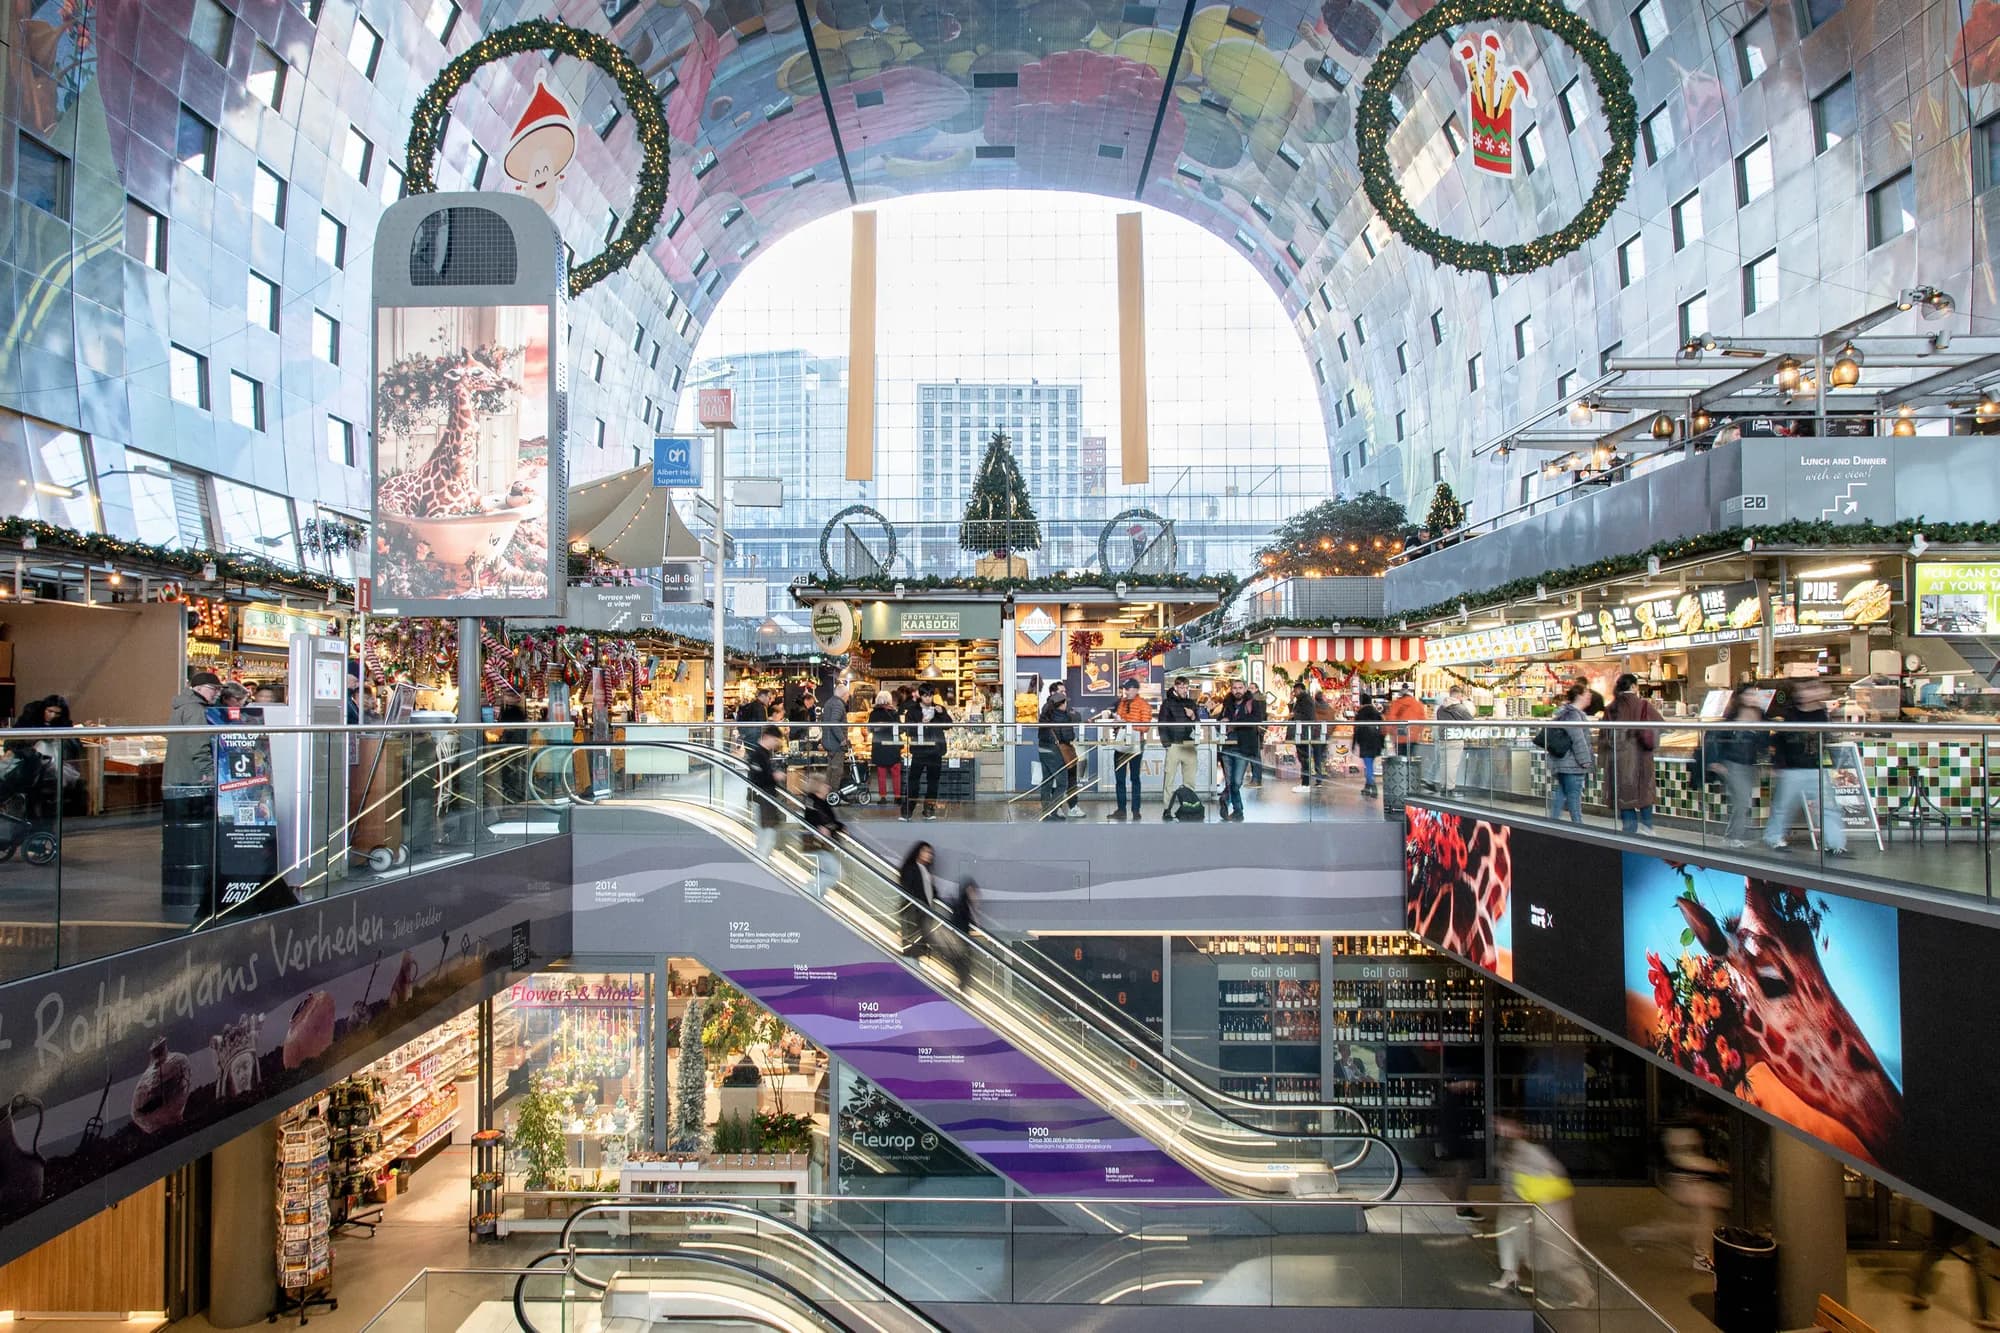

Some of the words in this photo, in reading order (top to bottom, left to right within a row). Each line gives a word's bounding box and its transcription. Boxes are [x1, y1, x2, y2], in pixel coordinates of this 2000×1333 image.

[1805, 469, 1829, 481] with
[1844, 466, 1873, 479] view!
[657, 477, 698, 485] Supermarkt
[1744, 496, 1766, 509] 20
[1924, 568, 1953, 578] YOU
[1956, 568, 1985, 577] CAN
[664, 574, 680, 584] Gall
[684, 574, 700, 584] Gall
[1802, 582, 1838, 600] PIDE
[1930, 581, 1945, 591] AT
[1949, 581, 1986, 591] YOUR
[614, 600, 631, 608] view
[903, 620, 958, 630] KAASDOK
[187, 637, 220, 657] Corona
[594, 881, 618, 890] 2014
[684, 880, 699, 888] 2001
[729, 922, 750, 931] 1972
[1251, 967, 1271, 978] Gall
[1276, 967, 1297, 978] Gall
[1362, 967, 1382, 978] Gall
[1388, 967, 1409, 978] Gall
[34, 950, 260, 1068] Rotterdams
[270, 912, 385, 978] Verheden
[392, 916, 414, 940] Jules
[511, 985, 572, 1001] Flowers
[577, 986, 590, 1001] &
[597, 985, 640, 1001] More
[858, 1002, 879, 1011] 1940
[918, 1047, 933, 1055] 1937
[1028, 1127, 1049, 1137] 1900
[852, 1131, 915, 1151] Fleurop
